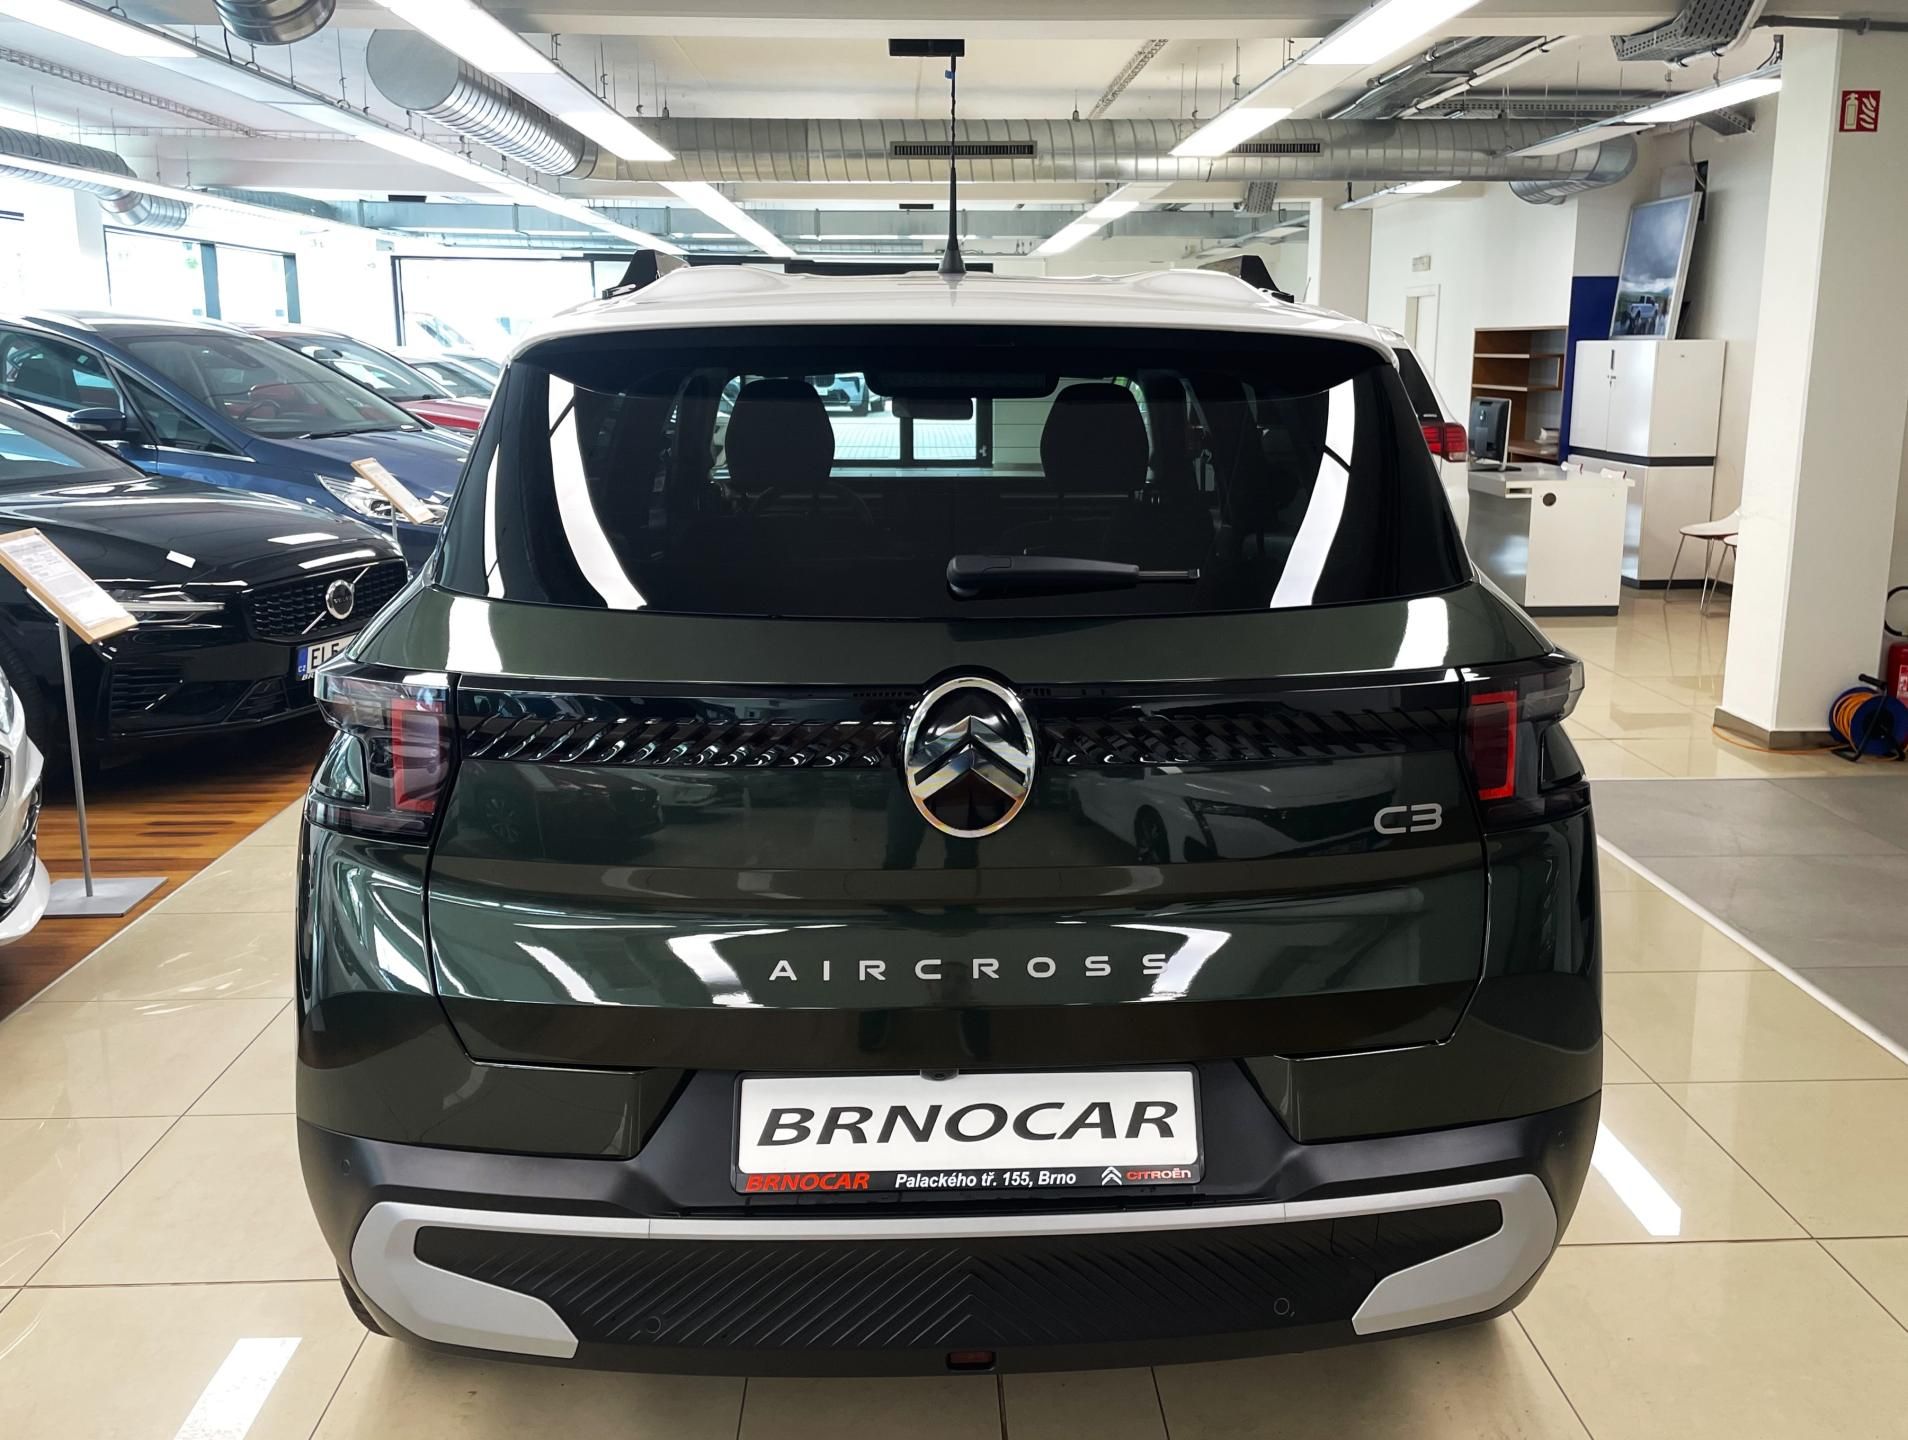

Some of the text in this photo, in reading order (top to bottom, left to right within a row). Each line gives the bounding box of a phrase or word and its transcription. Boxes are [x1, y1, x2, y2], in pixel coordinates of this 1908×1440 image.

[1373, 803, 1442, 834] C3
[769, 953, 1168, 981] AIRCROSS
[757, 1101, 1179, 1146] BRNOCAR
[745, 1172, 870, 1192] BRNOCAR
[895, 1170, 1077, 1188] Palackého tř. 155, Brno
